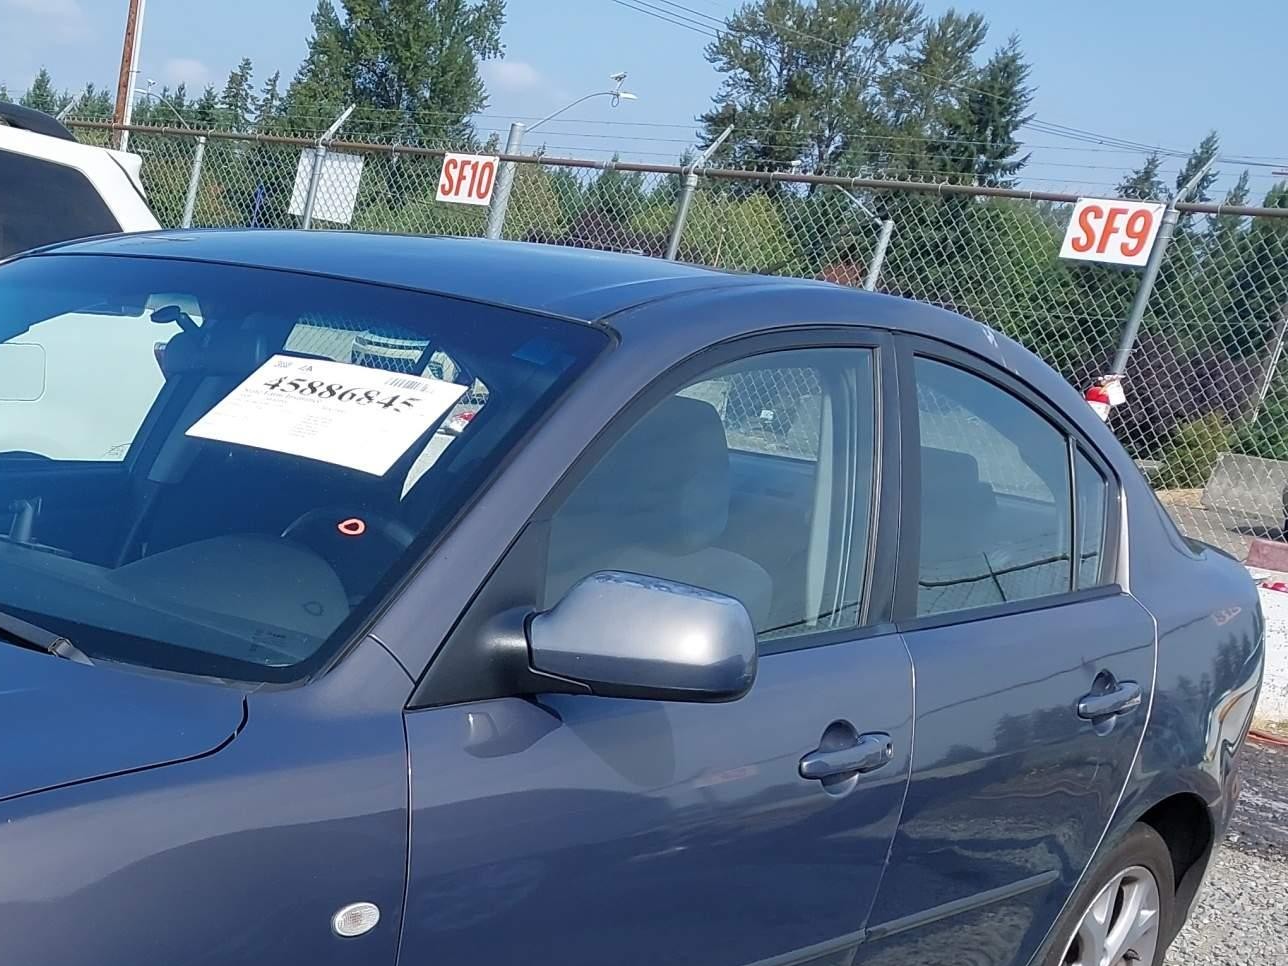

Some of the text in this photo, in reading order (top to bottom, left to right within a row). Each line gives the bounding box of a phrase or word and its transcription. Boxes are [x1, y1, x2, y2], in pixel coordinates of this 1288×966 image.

[440, 158, 495, 199] SF10
[1071, 205, 1153, 257] SF9
[263, 376, 422, 413] 45886845
